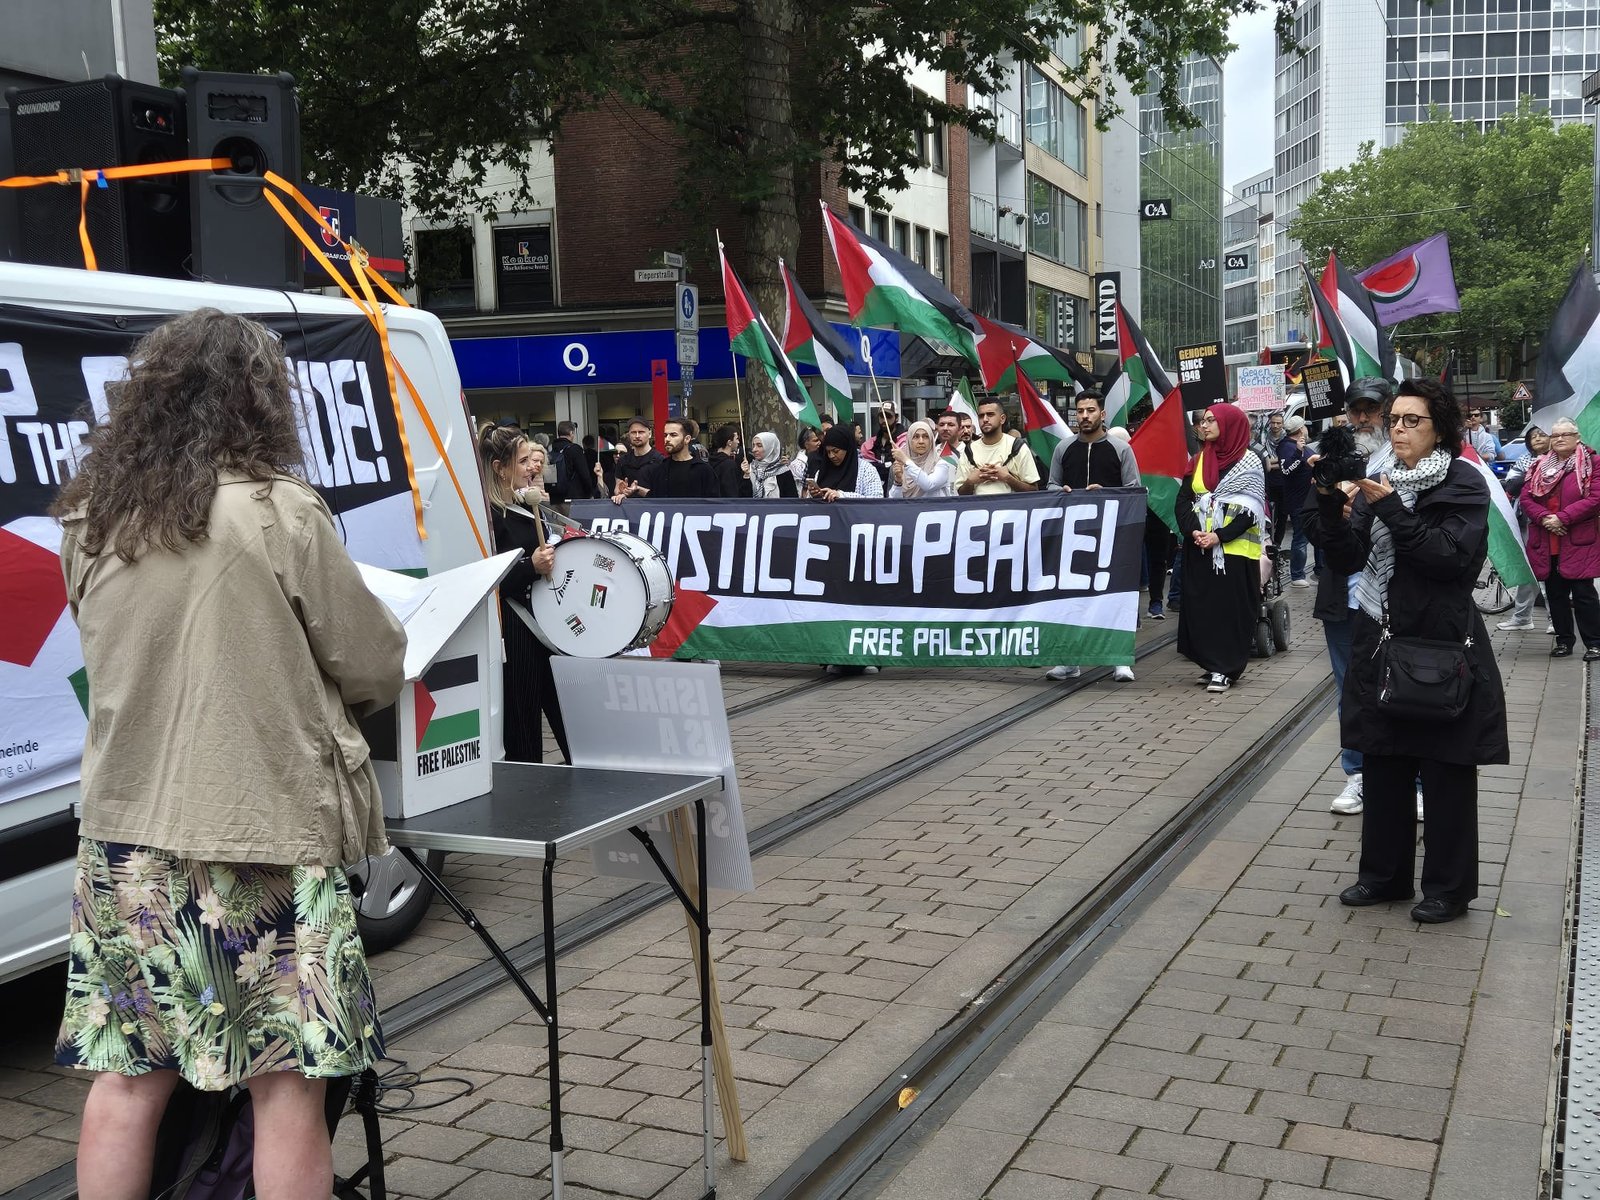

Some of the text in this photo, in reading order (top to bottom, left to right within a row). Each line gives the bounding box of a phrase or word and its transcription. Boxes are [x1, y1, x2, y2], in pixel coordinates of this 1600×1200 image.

[17, 101, 61, 115] SOUNDBOKS
[1144, 203, 1168, 217] C&A
[1228, 257, 1245, 267] C&A
[638, 270, 674, 280] Pieperstraße
[1099, 279, 1116, 343] KIND
[1178, 345, 1218, 360] GENOCIDE
[1180, 358, 1204, 371] SINCE
[1181, 370, 1201, 382] 1948
[1312, 399, 1334, 408] STILLE.
[912, 499, 1119, 594] PEACE!
[849, 627, 1040, 656] FREE PALESTINE!
[417, 740, 480, 777] FREE PALESTINE
